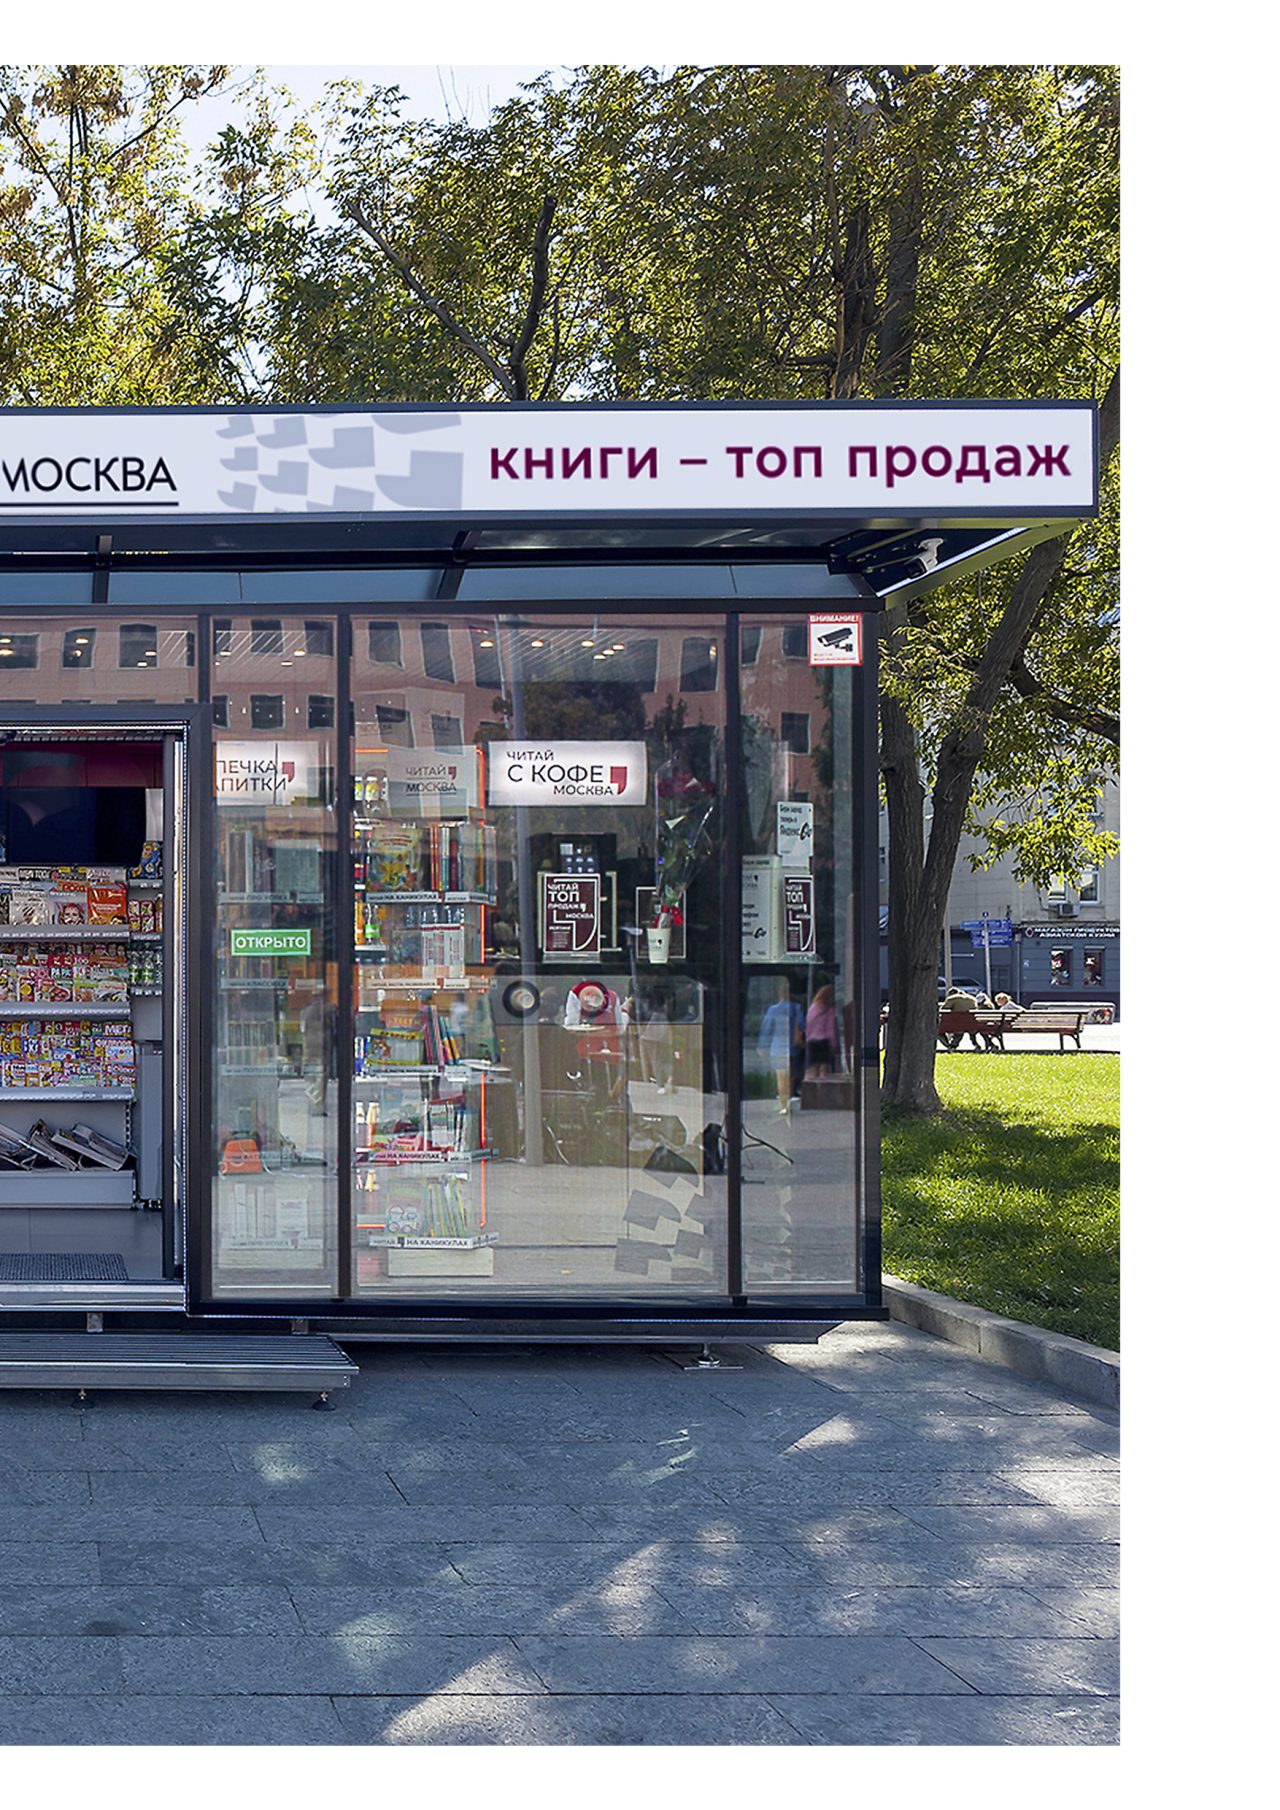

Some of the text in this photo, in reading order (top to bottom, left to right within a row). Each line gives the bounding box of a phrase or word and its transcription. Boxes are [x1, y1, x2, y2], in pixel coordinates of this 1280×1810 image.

[489, 447, 658, 480] книги
[725, 446, 820, 479] топ
[848, 442, 1073, 487] продаж
[2, 457, 177, 492] МОСКВА
[507, 750, 554, 761] ЧИТАЙ
[406, 764, 446, 776] ЧИТАЙ
[507, 764, 603, 783] С КОФЕ
[216, 778, 286, 791] ПИТКИ
[406, 781, 457, 792] МОСКВА
[553, 785, 614, 796] МОСКВА
[547, 883, 578, 891] ЧИТАЙ
[548, 891, 579, 902] ТОП
[786, 891, 804, 903] ТОП
[235, 936, 306, 949] ОТКРЫТО
